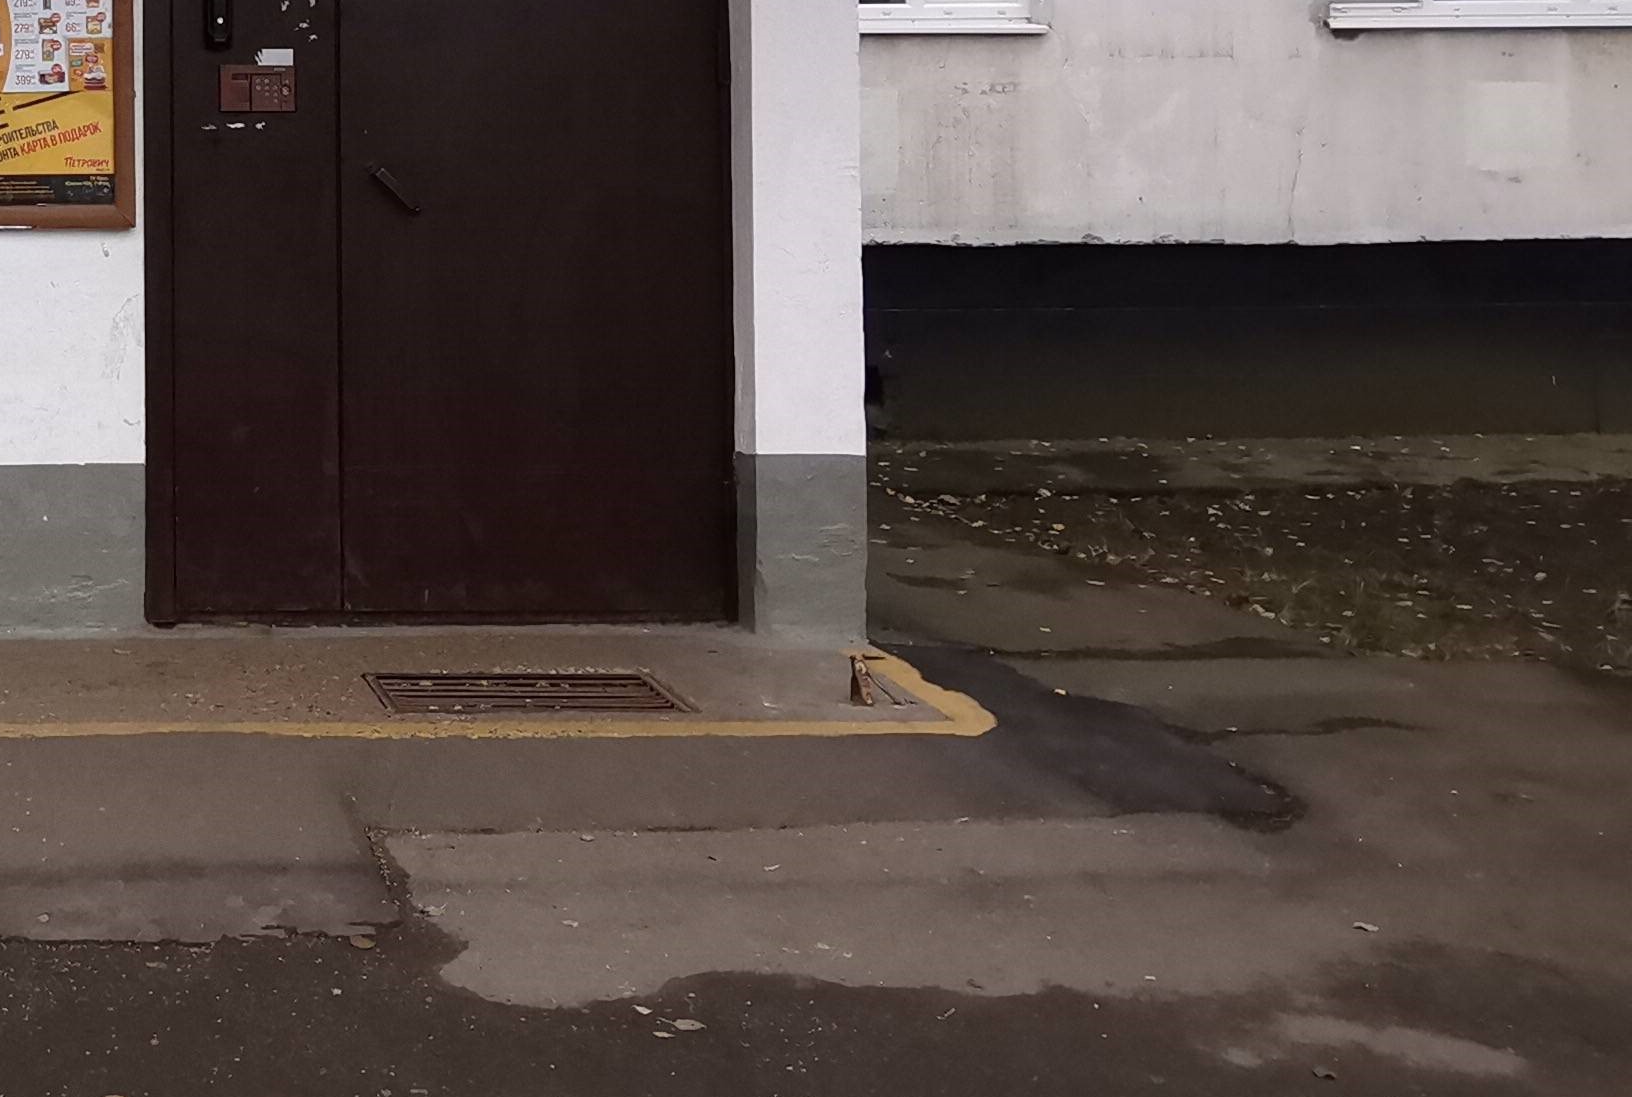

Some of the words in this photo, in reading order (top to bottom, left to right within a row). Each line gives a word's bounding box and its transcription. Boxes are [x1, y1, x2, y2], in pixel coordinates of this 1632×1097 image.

[20, 137, 51, 157] КАРТА
[51, 135, 58, 147] В
[58, 121, 103, 144] ПОДАРОК
